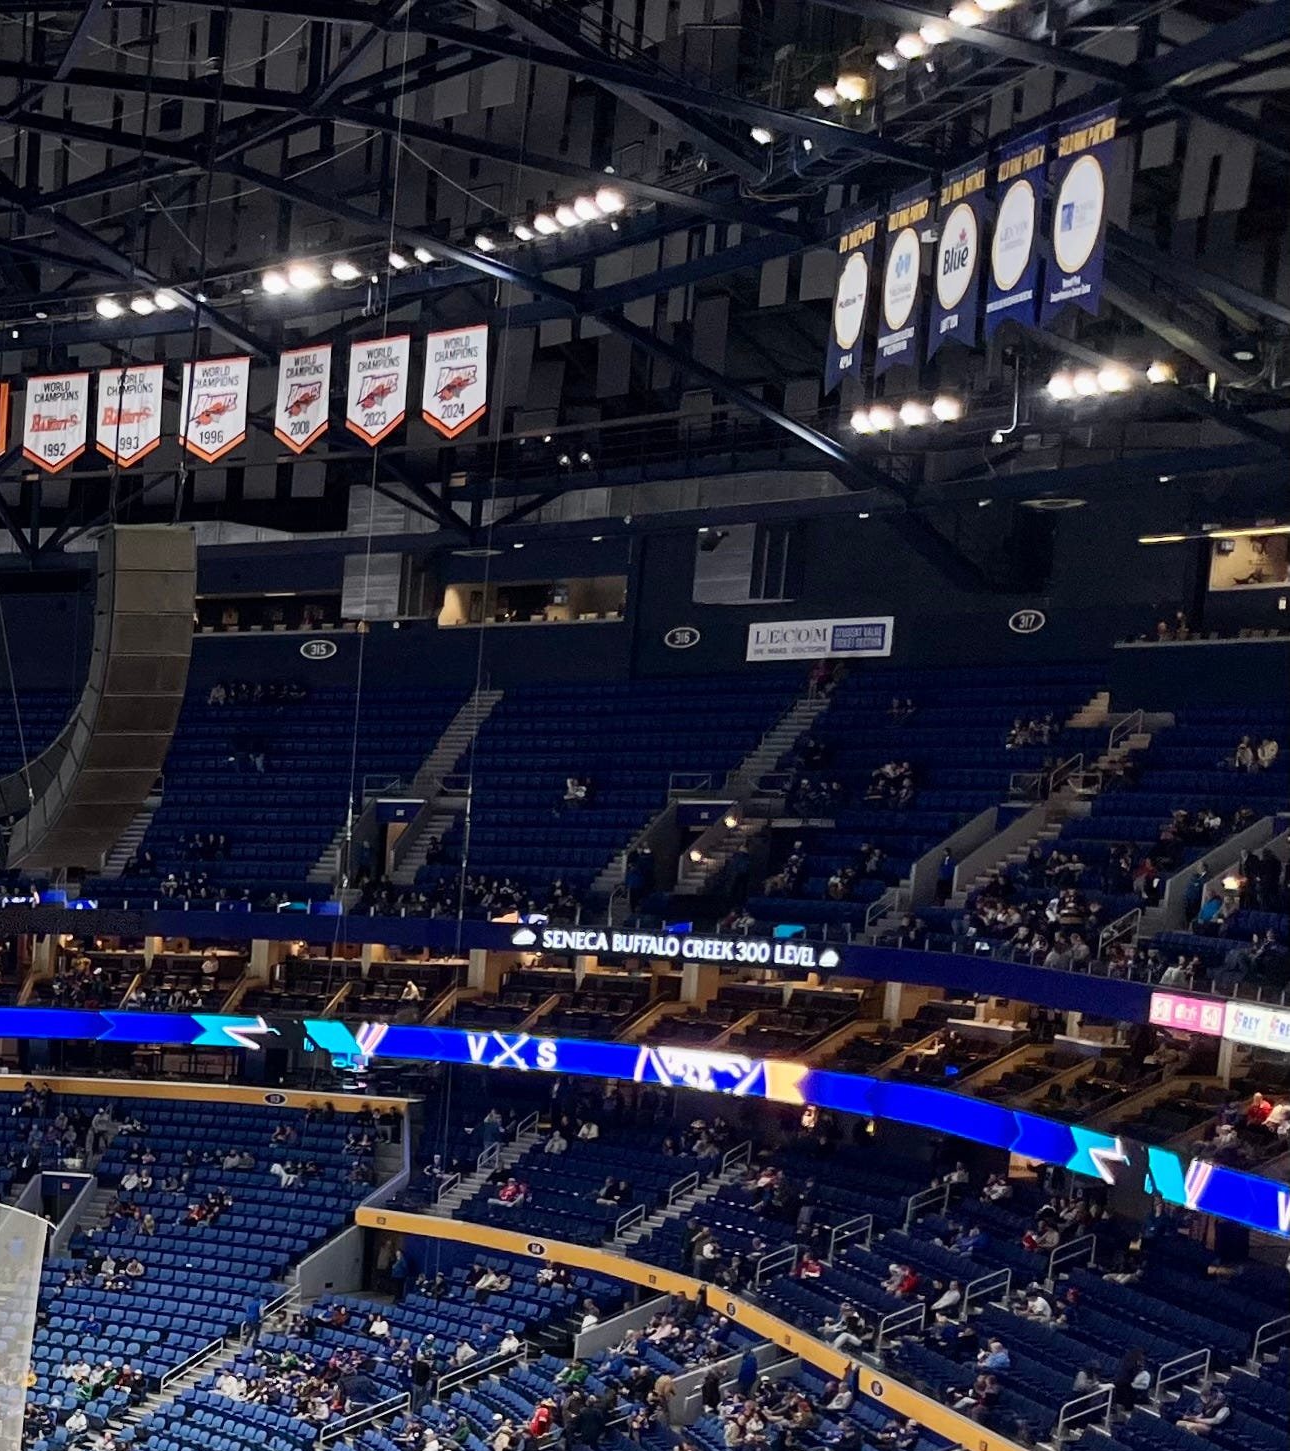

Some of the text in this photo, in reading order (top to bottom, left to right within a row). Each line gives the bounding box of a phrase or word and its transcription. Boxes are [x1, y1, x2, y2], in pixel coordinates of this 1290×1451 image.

[943, 246, 969, 277] Blue
[443, 336, 470, 348] WORLD
[294, 354, 317, 366] WORLD
[366, 347, 393, 359] WORLD
[434, 347, 478, 363] CHAMPIONS
[201, 366, 230, 377] WORLD
[286, 364, 324, 379] CHAMPIONS
[357, 358, 400, 372] CHAMPIONS
[43, 380, 70, 392] WORLD
[106, 383, 153, 395] CHAMPIONS
[34, 391, 79, 403] CHAMPIONS
[441, 404, 465, 419] 2024
[363, 412, 386, 427] 2023
[199, 430, 224, 445] 1996
[43, 443, 66, 457] 1992
[755, 628, 828, 644] LECOM
[542, 930, 816, 967] SENECA BUFFALO CREEK 300 LEVEL
